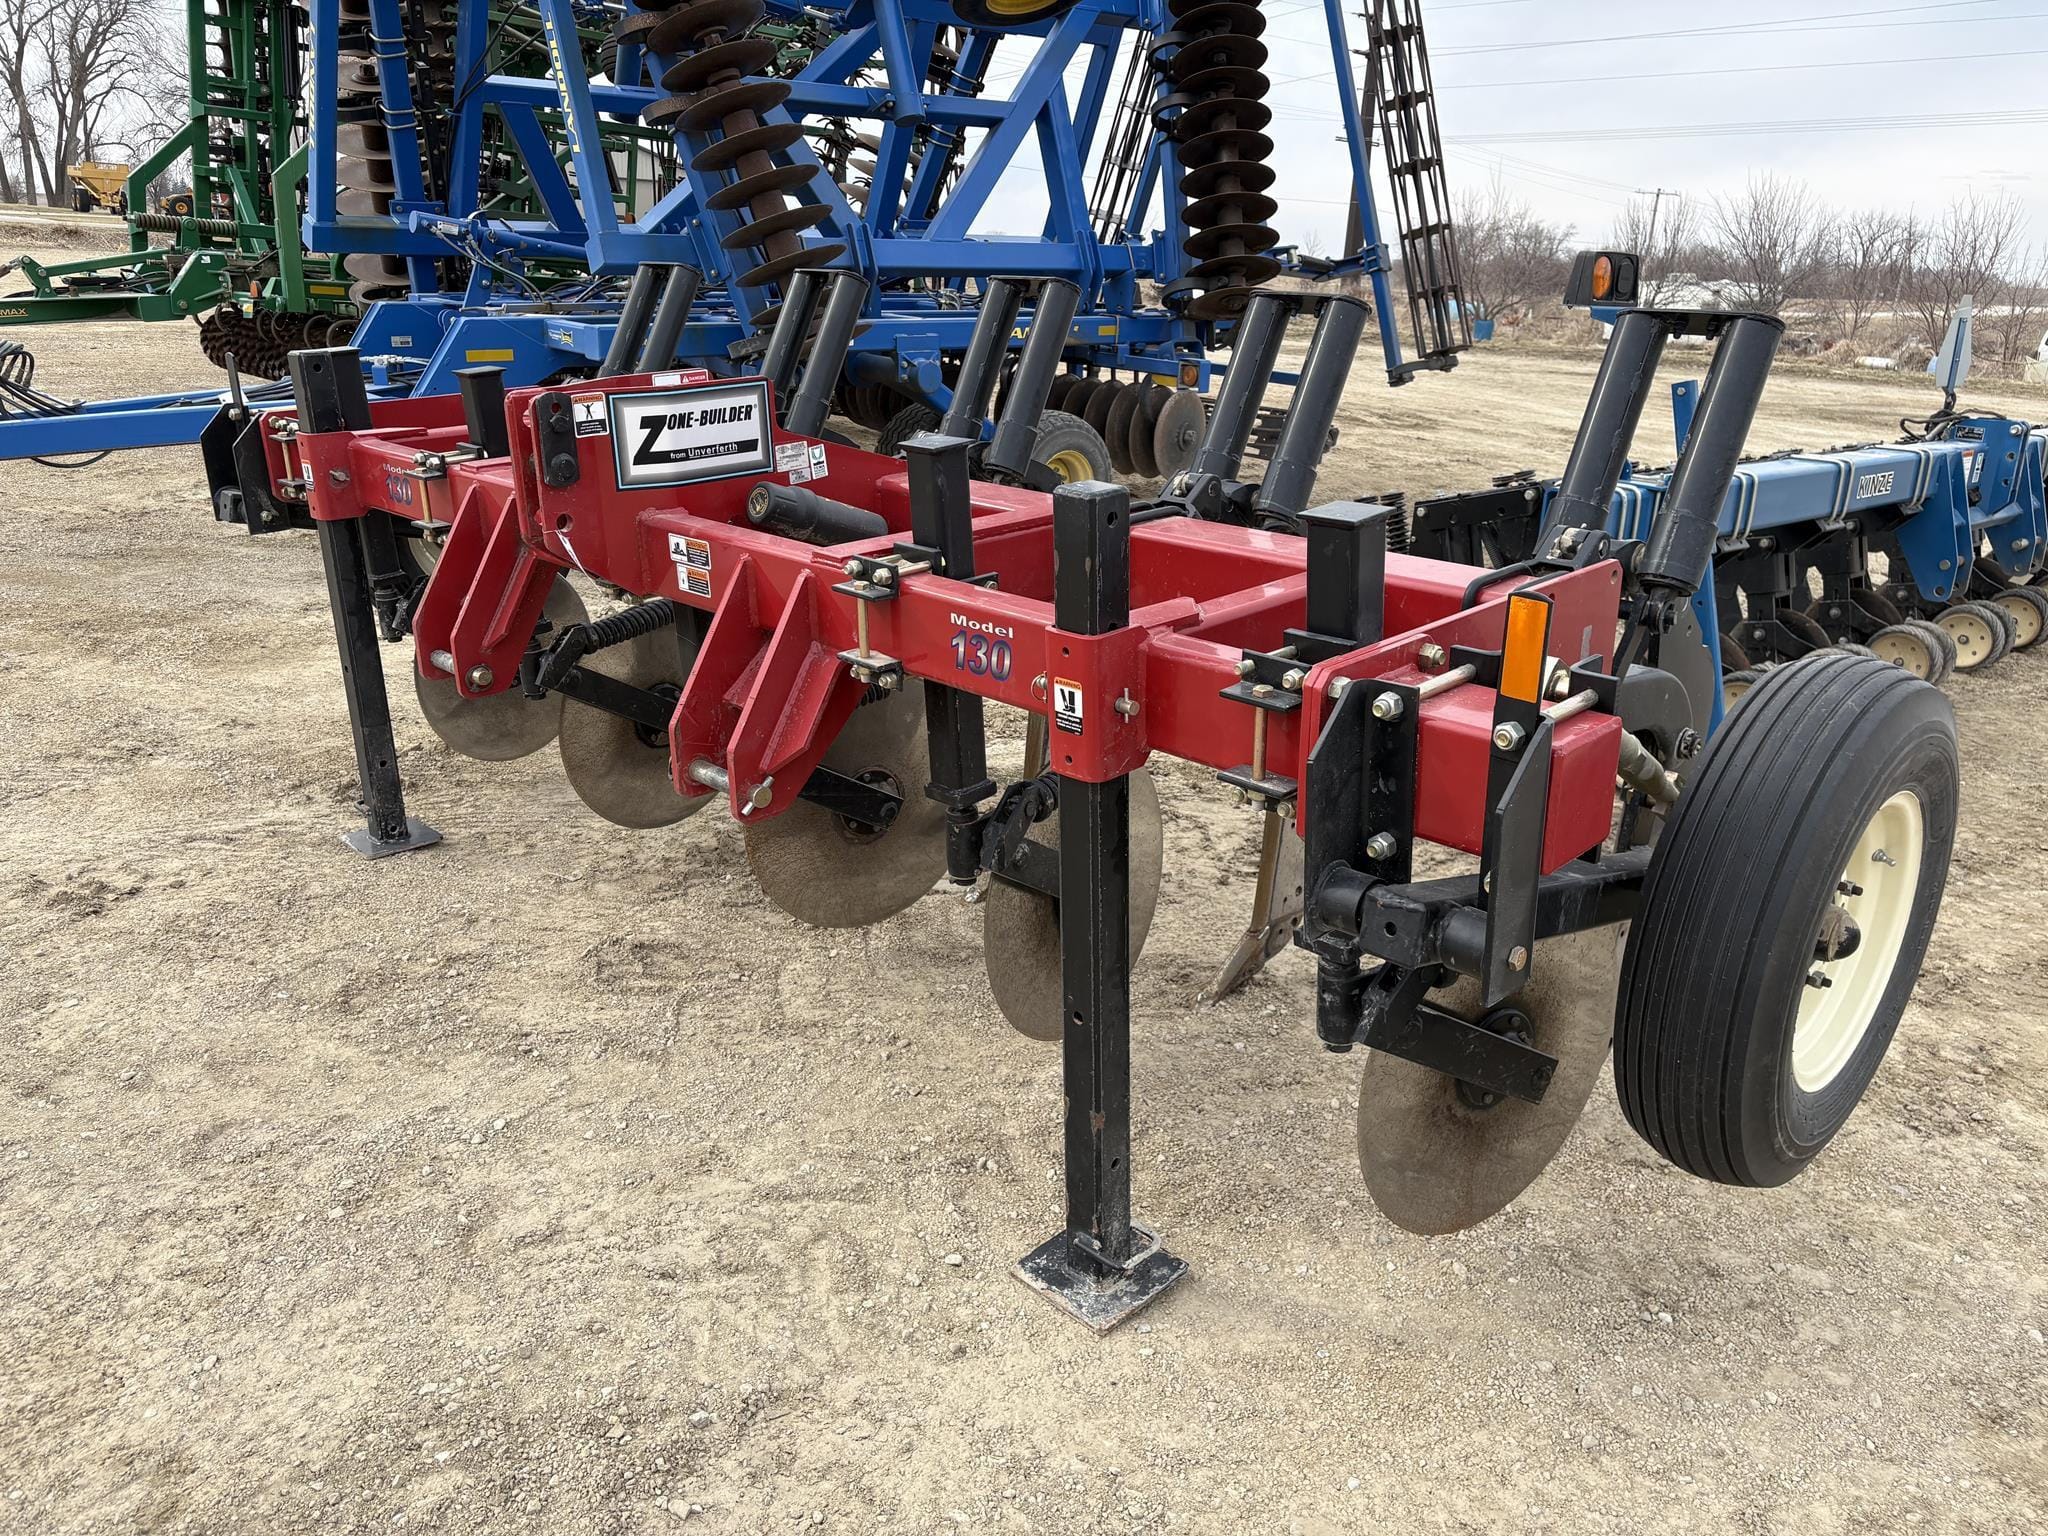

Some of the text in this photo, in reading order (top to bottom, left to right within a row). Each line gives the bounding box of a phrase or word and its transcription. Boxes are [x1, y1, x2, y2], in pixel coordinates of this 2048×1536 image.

[545, 11, 581, 153] LANDOLL
[633, 404, 756, 466] ZONE-BUILDER
[670, 442, 738, 460] from Unverferth
[386, 473, 413, 506] 130
[1856, 470, 1895, 500] KINZE
[950, 612, 1014, 639] Model
[951, 629, 1012, 682] 130
